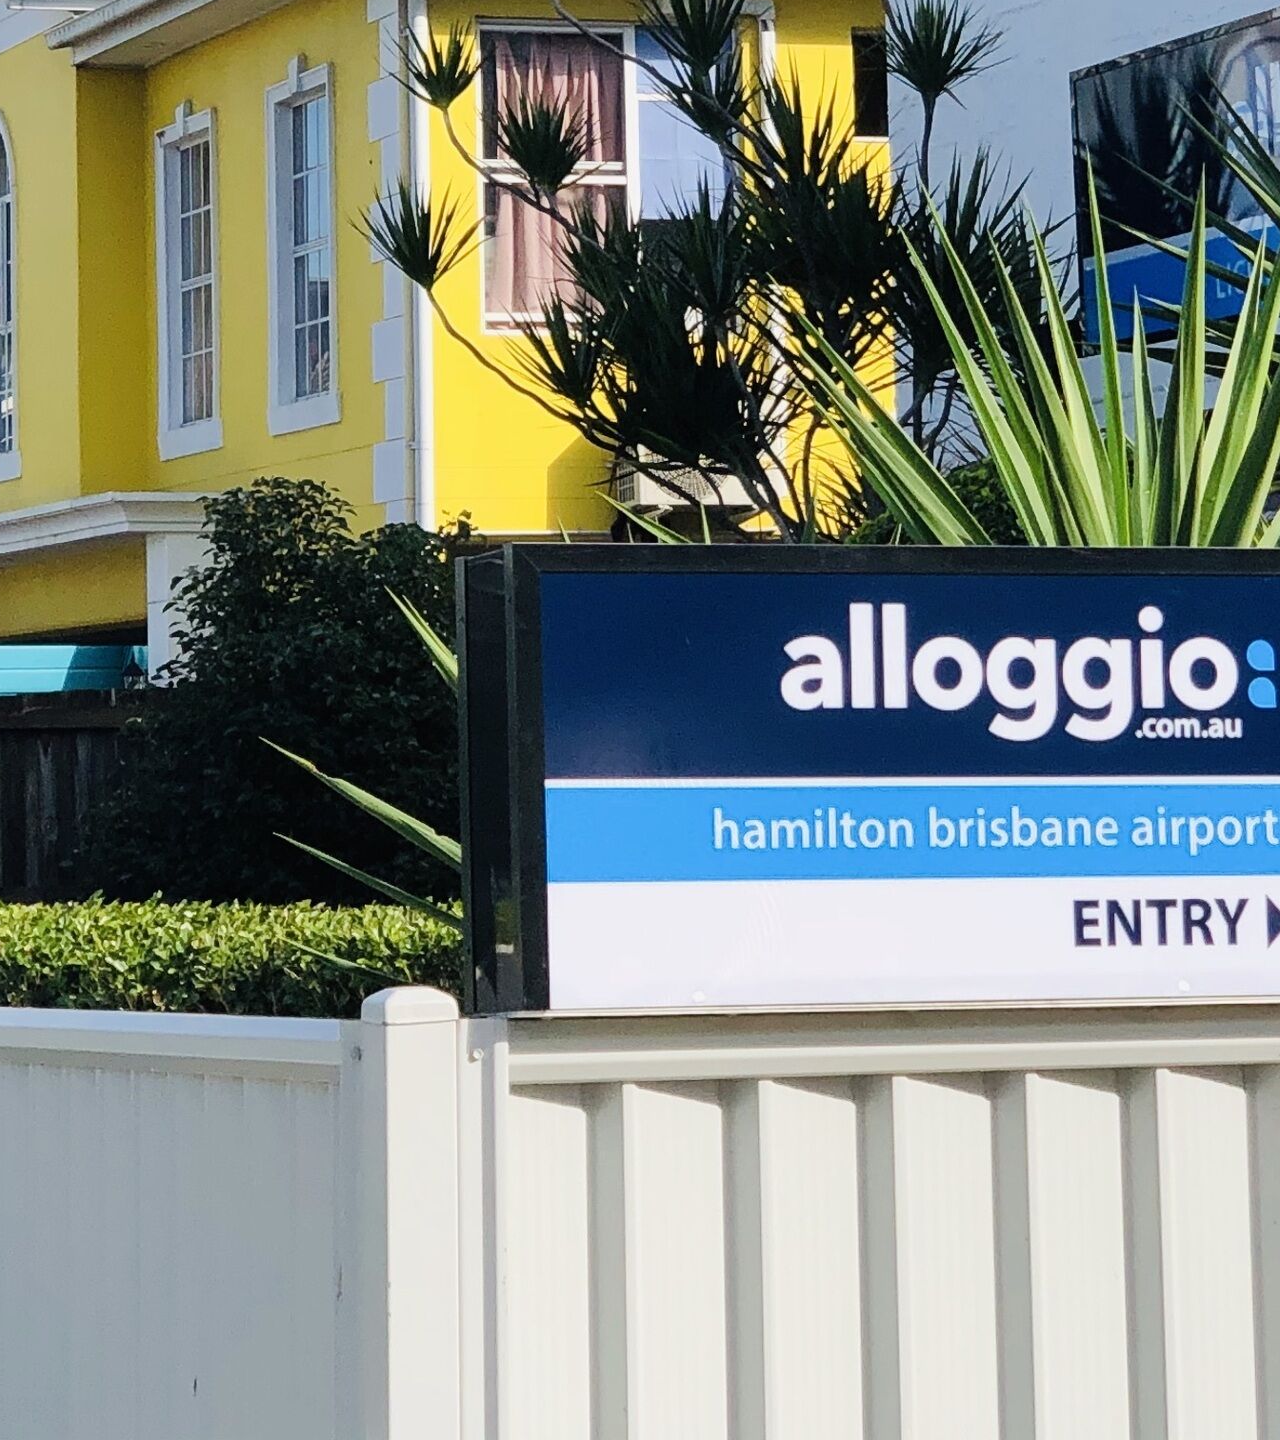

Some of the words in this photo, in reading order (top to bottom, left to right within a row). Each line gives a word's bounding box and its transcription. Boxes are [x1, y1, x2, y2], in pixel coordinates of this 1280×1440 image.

[1135, 715, 1243, 739] .com.au
[713, 808, 914, 849] hamilton
[928, 806, 1119, 847] brisbane
[1131, 807, 1279, 855] airport
[1074, 898, 1248, 947] ENTRY
